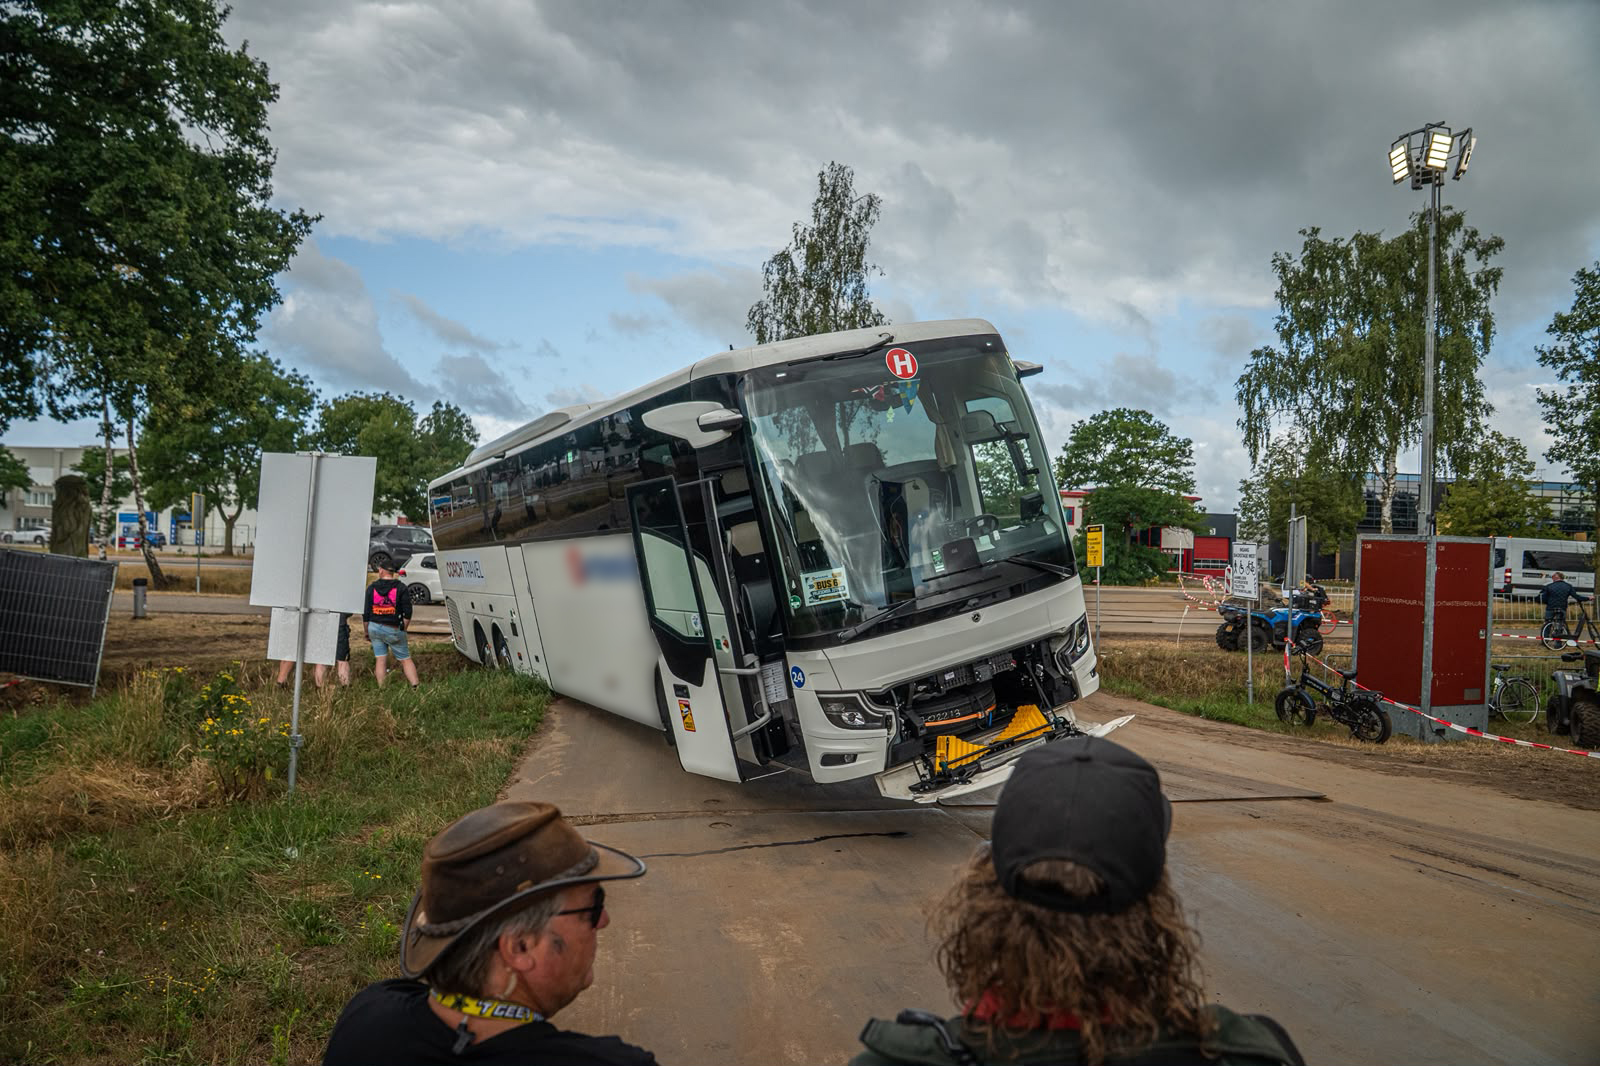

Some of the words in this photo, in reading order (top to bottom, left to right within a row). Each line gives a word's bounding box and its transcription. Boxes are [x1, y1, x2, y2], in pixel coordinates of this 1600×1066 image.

[893, 353, 914, 375] H
[446, 561, 464, 577] COACH
[462, 560, 485, 579] TRAVEL
[816, 579, 833, 590] BUS
[792, 672, 804, 682] 24
